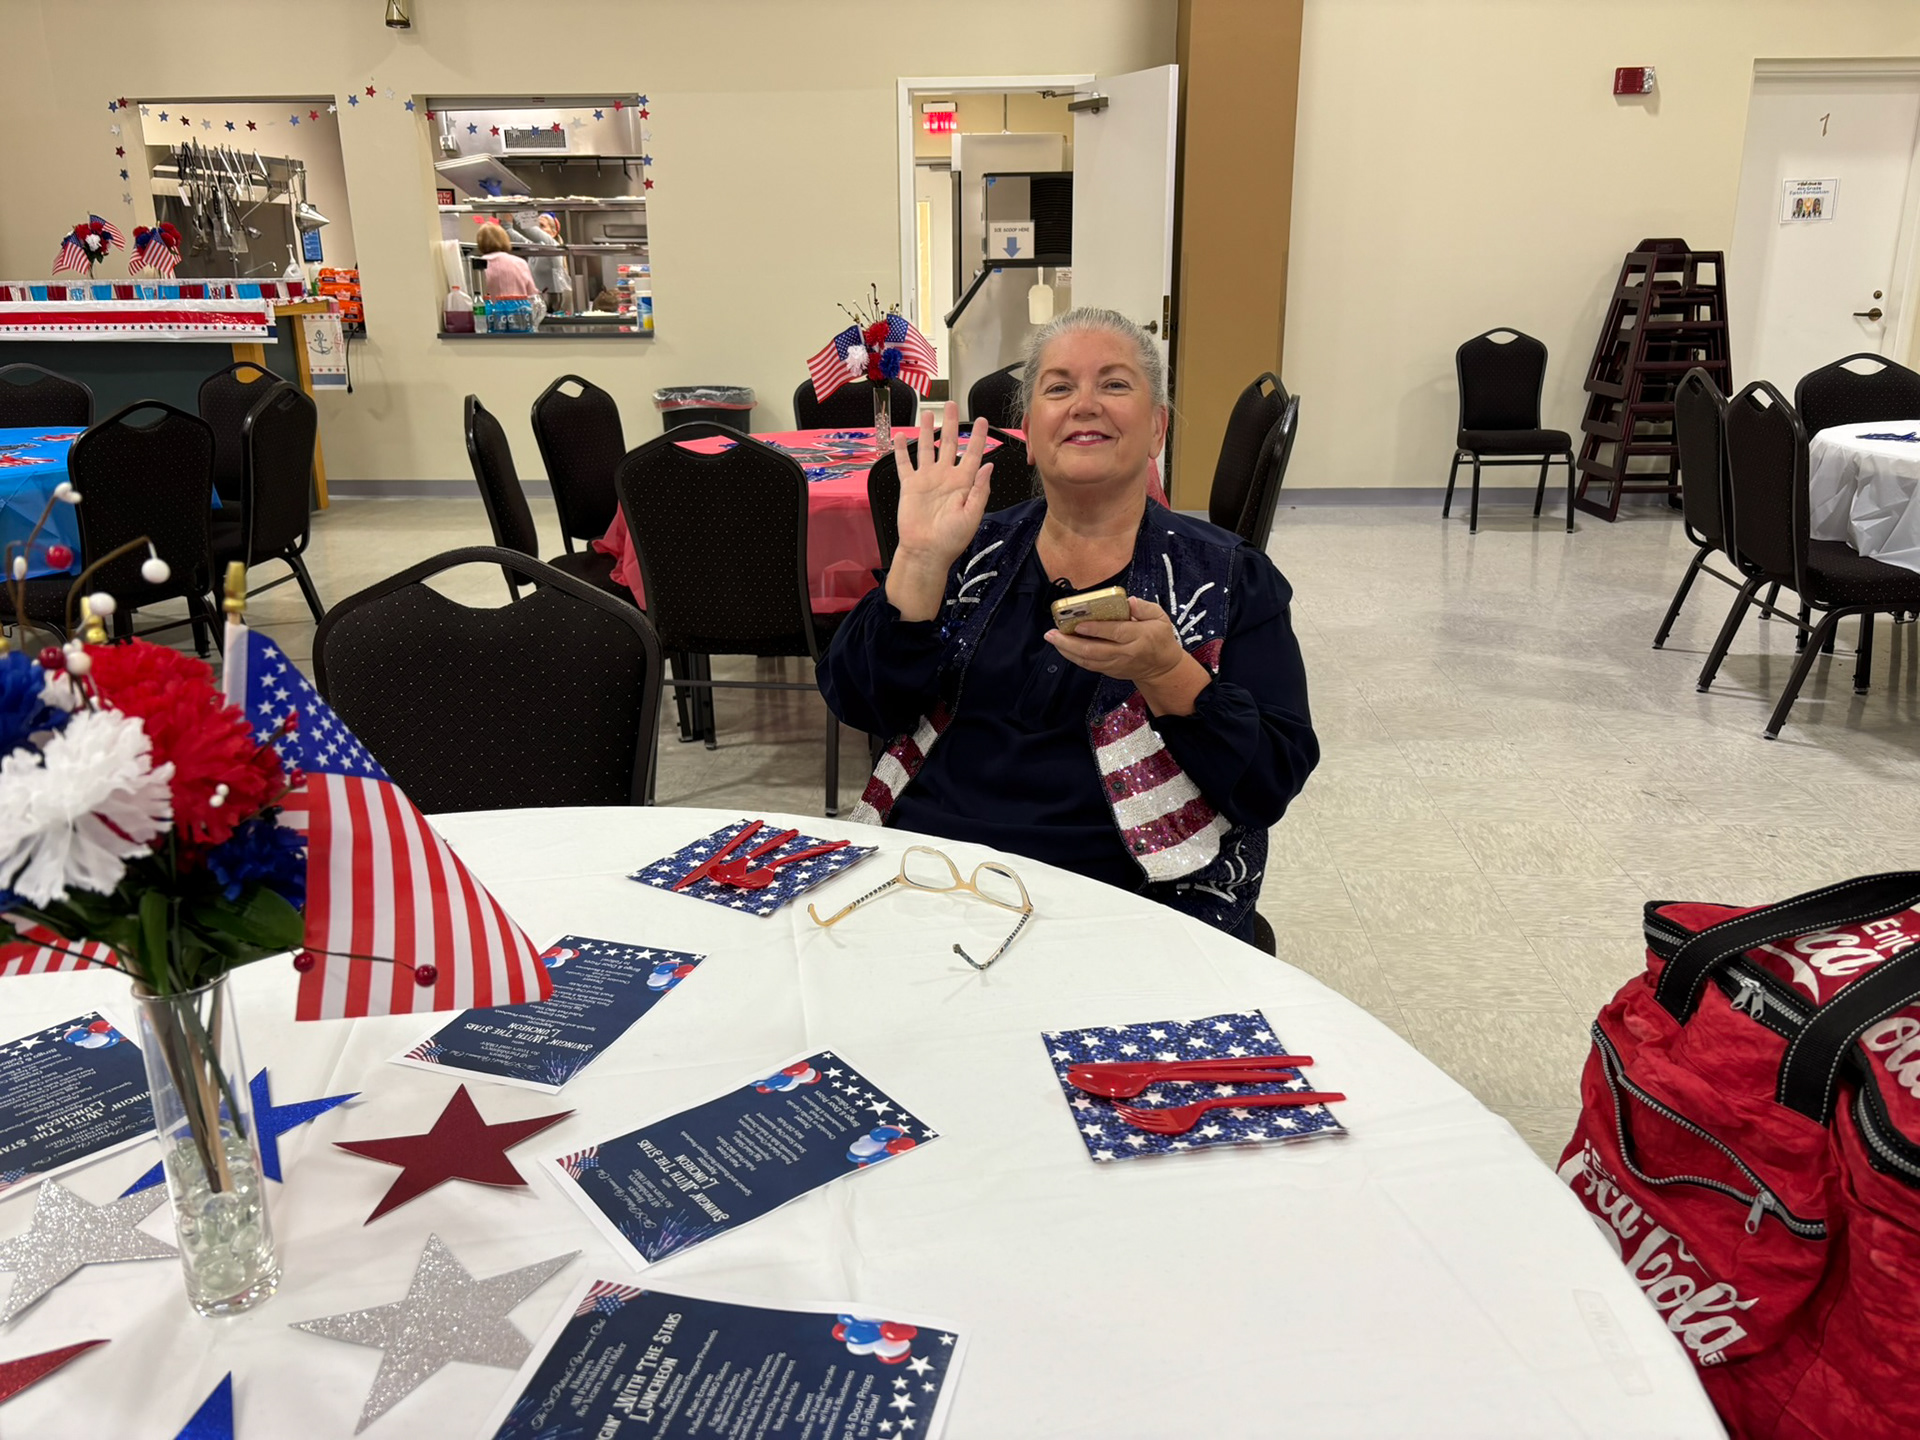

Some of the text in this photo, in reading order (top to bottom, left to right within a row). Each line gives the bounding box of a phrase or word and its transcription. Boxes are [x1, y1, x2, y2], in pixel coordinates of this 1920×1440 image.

[491, 1028, 513, 1037] THE
[507, 1022, 561, 1037] LUNCHEON
[515, 1032, 548, 1043] WITH
[814, 1090, 830, 1103] Prizes
[827, 1101, 842, 1112] Door
[35, 1100, 105, 1131] LUNCHEON
[65, 1108, 103, 1128] WITH
[793, 1114, 812, 1129] Dessert
[844, 1114, 860, 1127] Bingo
[30, 1127, 62, 1141] THE
[637, 1139, 662, 1158] STARS
[654, 1155, 676, 1173] THE
[674, 1154, 719, 1189] LUNCHEON
[728, 1157, 741, 1168] Main
[627, 1185, 645, 1203] Honors
[628, 1174, 655, 1202] Parishioners
[669, 1171, 699, 1191] WITH
[569, 1359, 594, 1389] Honors
[577, 1346, 613, 1394] Parishioners
[599, 1364, 613, 1380] and
[607, 1342, 626, 1364] Older
[613, 1374, 646, 1413] WITH
[635, 1345, 663, 1371] THE
[653, 1313, 681, 1343] STARS
[677, 1380, 690, 1394] Red
[685, 1357, 702, 1380] Pepper
[629, 1357, 677, 1422] LUNCHEON
[659, 1373, 683, 1408] Appetizer
[685, 1373, 713, 1417] Main Entree
[687, 1361, 731, 1435] Pulled Pork BBQ Sliders
[707, 1373, 740, 1427] Egg Salad Sliders
[746, 1404, 760, 1420] Balls
[757, 1377, 772, 1397] Italian
[766, 1352, 786, 1378] Dressing
[757, 1410, 772, 1431] Sized
[766, 1395, 780, 1410] Chip
[774, 1359, 796, 1395] Assortment
[810, 1390, 825, 1413] Vanilla
[819, 1364, 836, 1391] Cupcake
[834, 1370, 855, 1406] Blueberries
[847, 1399, 864, 1422] Door
[856, 1374, 874, 1399] Prizes
[728, 1416, 743, 1435] Salad
[742, 1385, 759, 1407] Cherry
[772, 1412, 788, 1431] Baby
[785, 1381, 800, 1400] Pickle
[795, 1392, 814, 1422] Dessert
[857, 1393, 880, 1436] to Follow!
